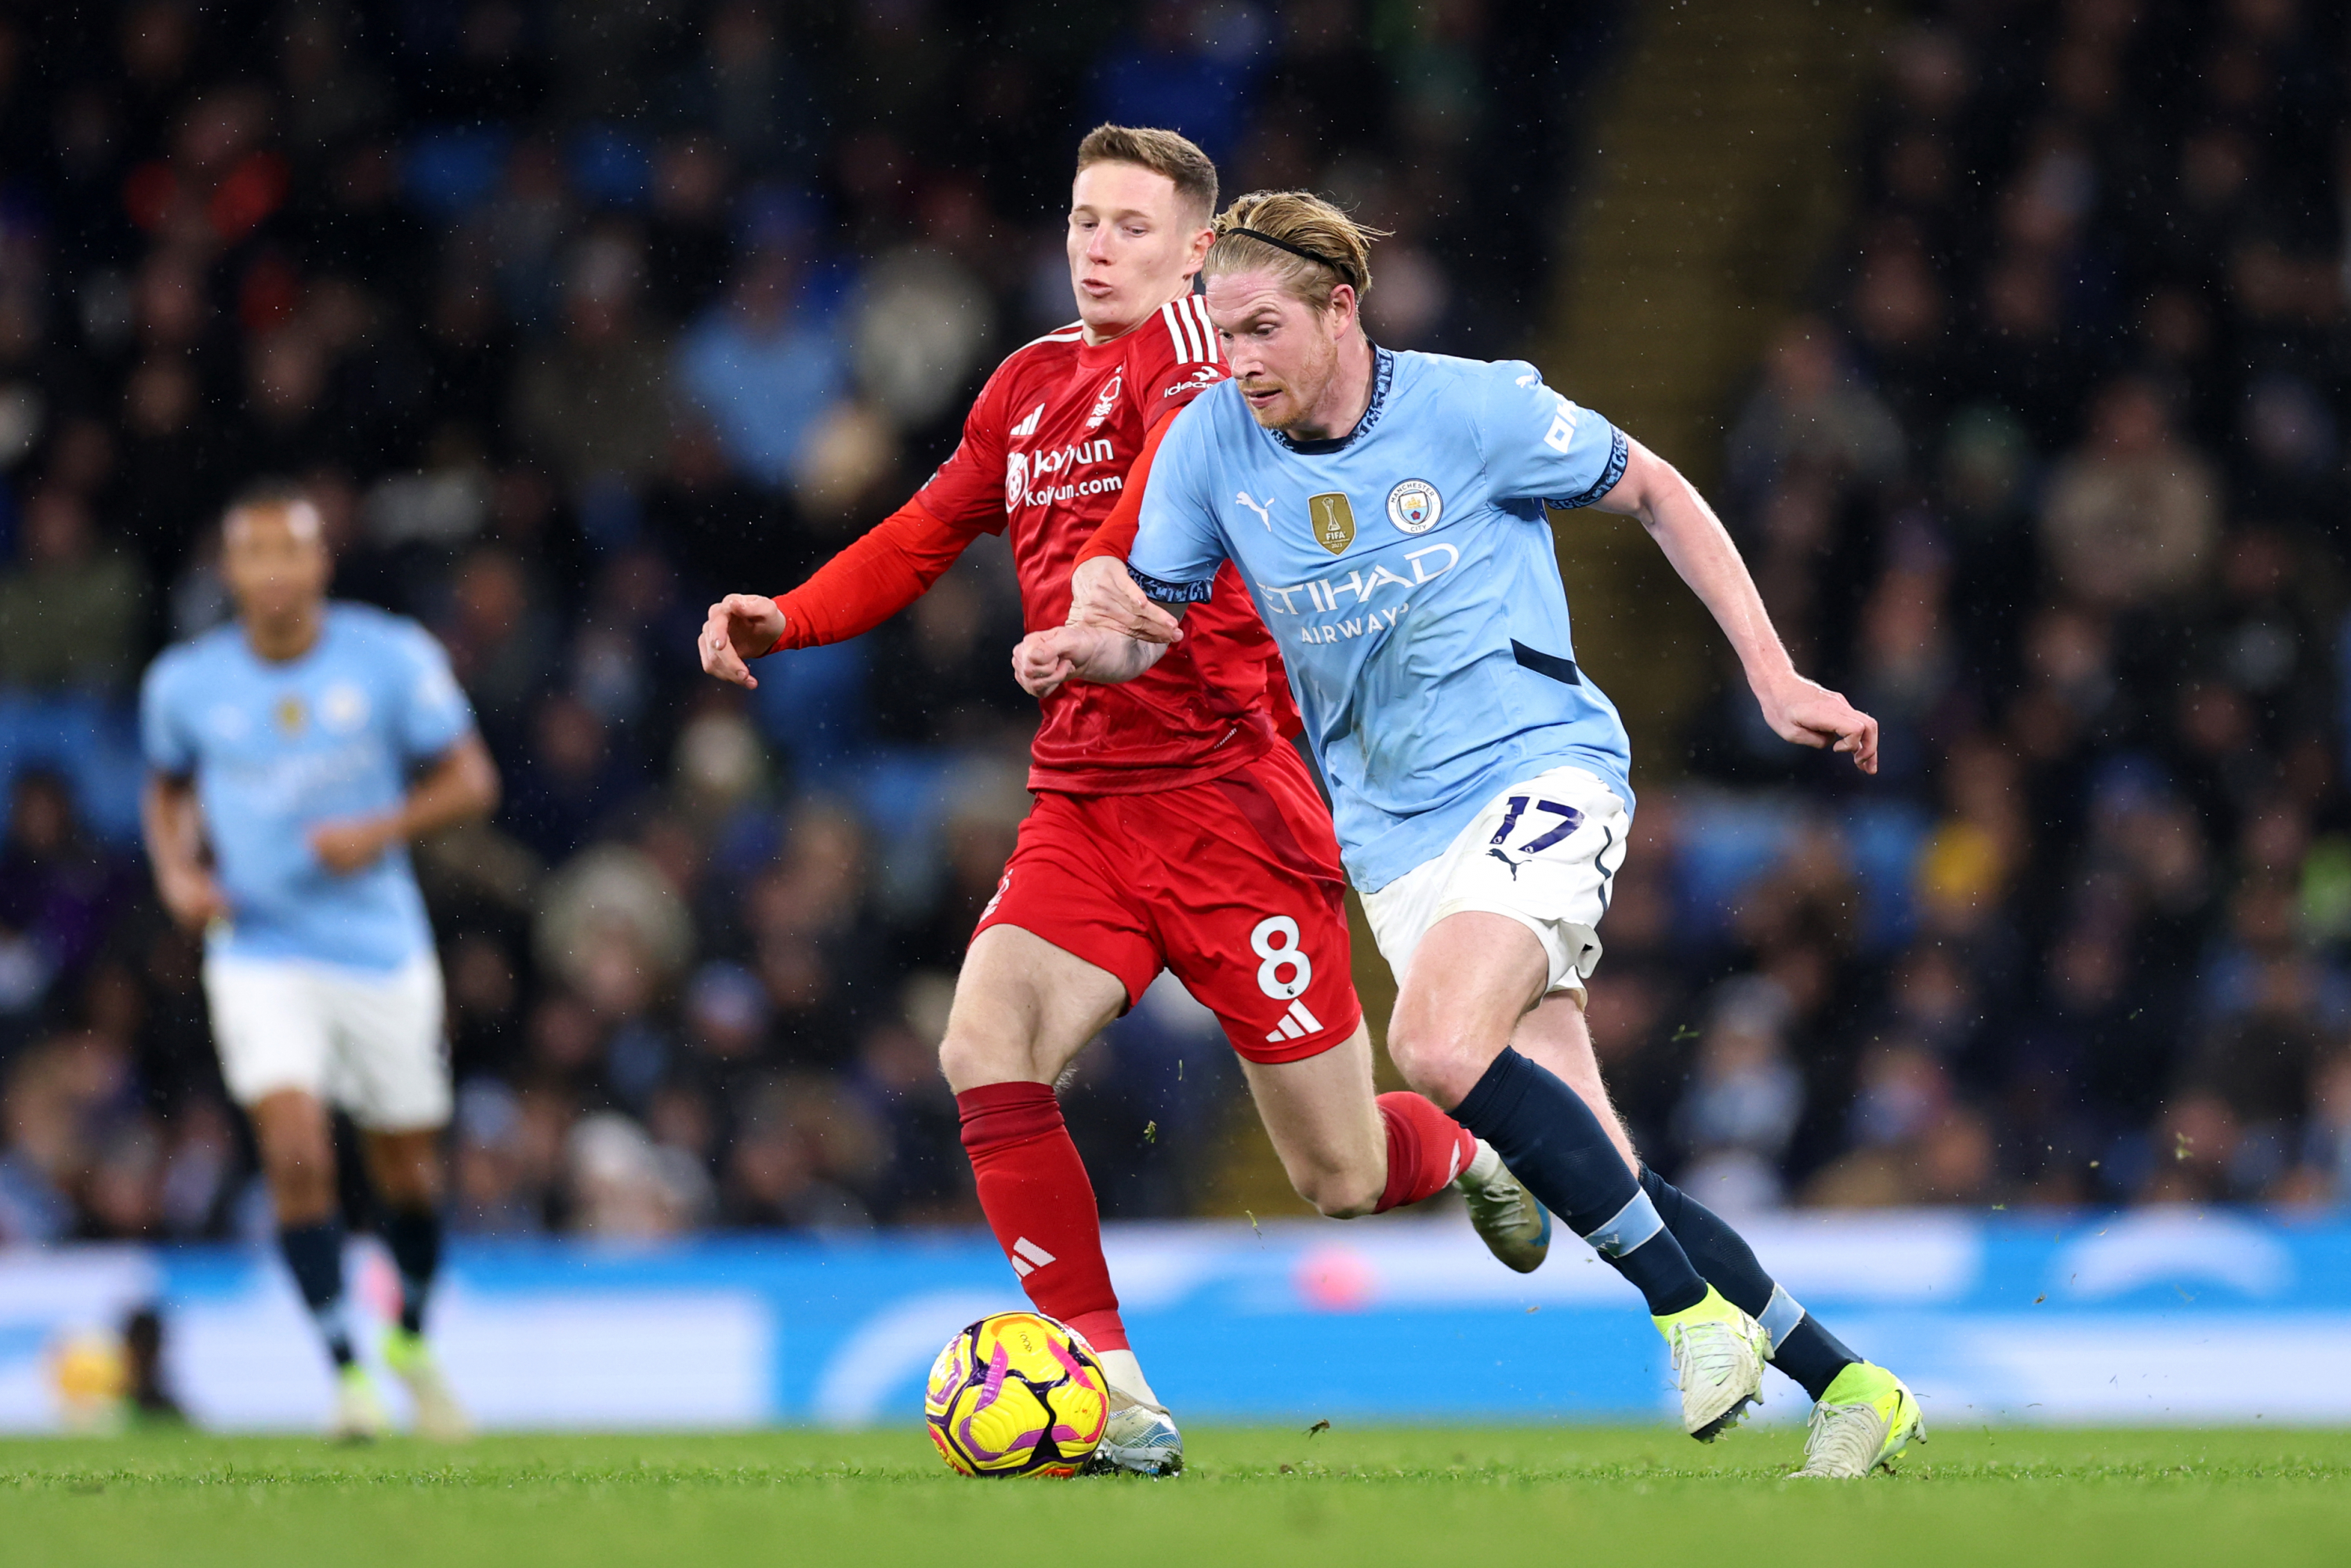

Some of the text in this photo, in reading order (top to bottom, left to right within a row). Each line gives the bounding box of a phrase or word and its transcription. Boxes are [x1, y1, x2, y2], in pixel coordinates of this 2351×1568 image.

[1391, 483, 1435, 503] MANCHESTER
[1326, 531, 1346, 541] FIFA
[1255, 543, 1460, 615] ETIHAD
[1490, 797, 1585, 854] 17
[1250, 915, 1312, 1000] 8
